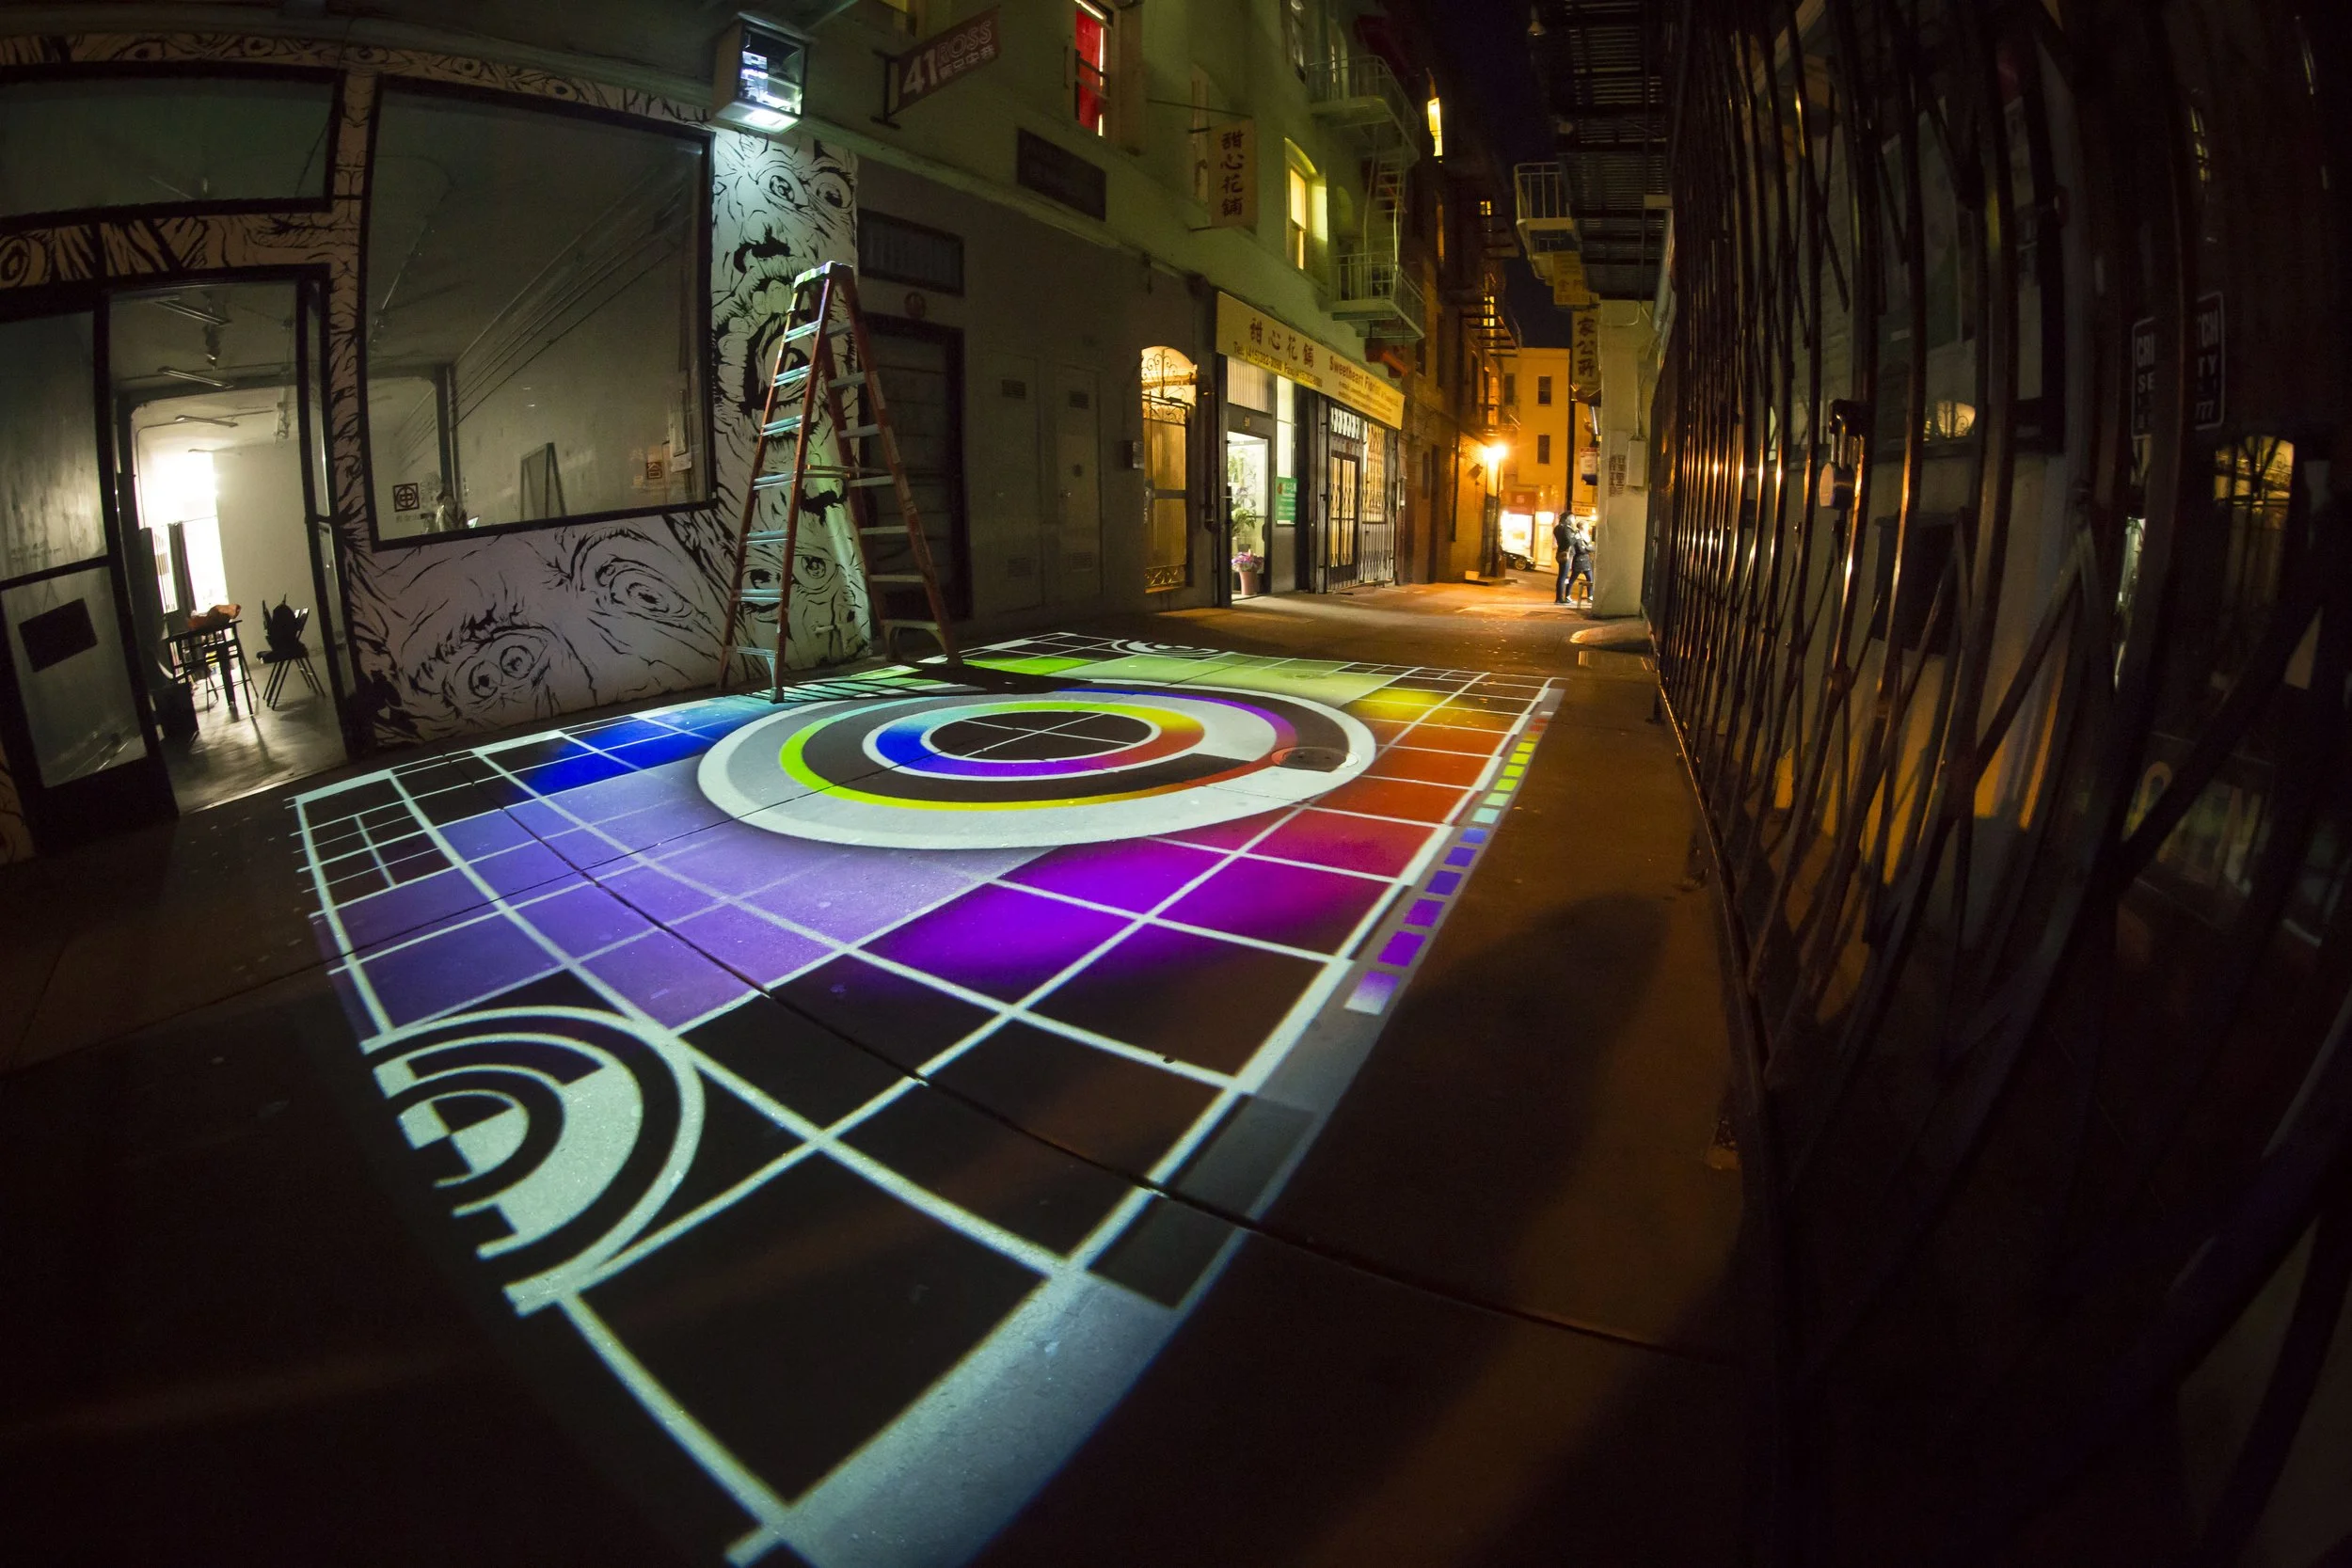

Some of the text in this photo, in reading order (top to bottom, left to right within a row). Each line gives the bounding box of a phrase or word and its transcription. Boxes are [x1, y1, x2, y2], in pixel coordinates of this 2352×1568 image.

[903, 19, 993, 94] 41 ROSS
[1329, 355, 1363, 387] Sweetheart
